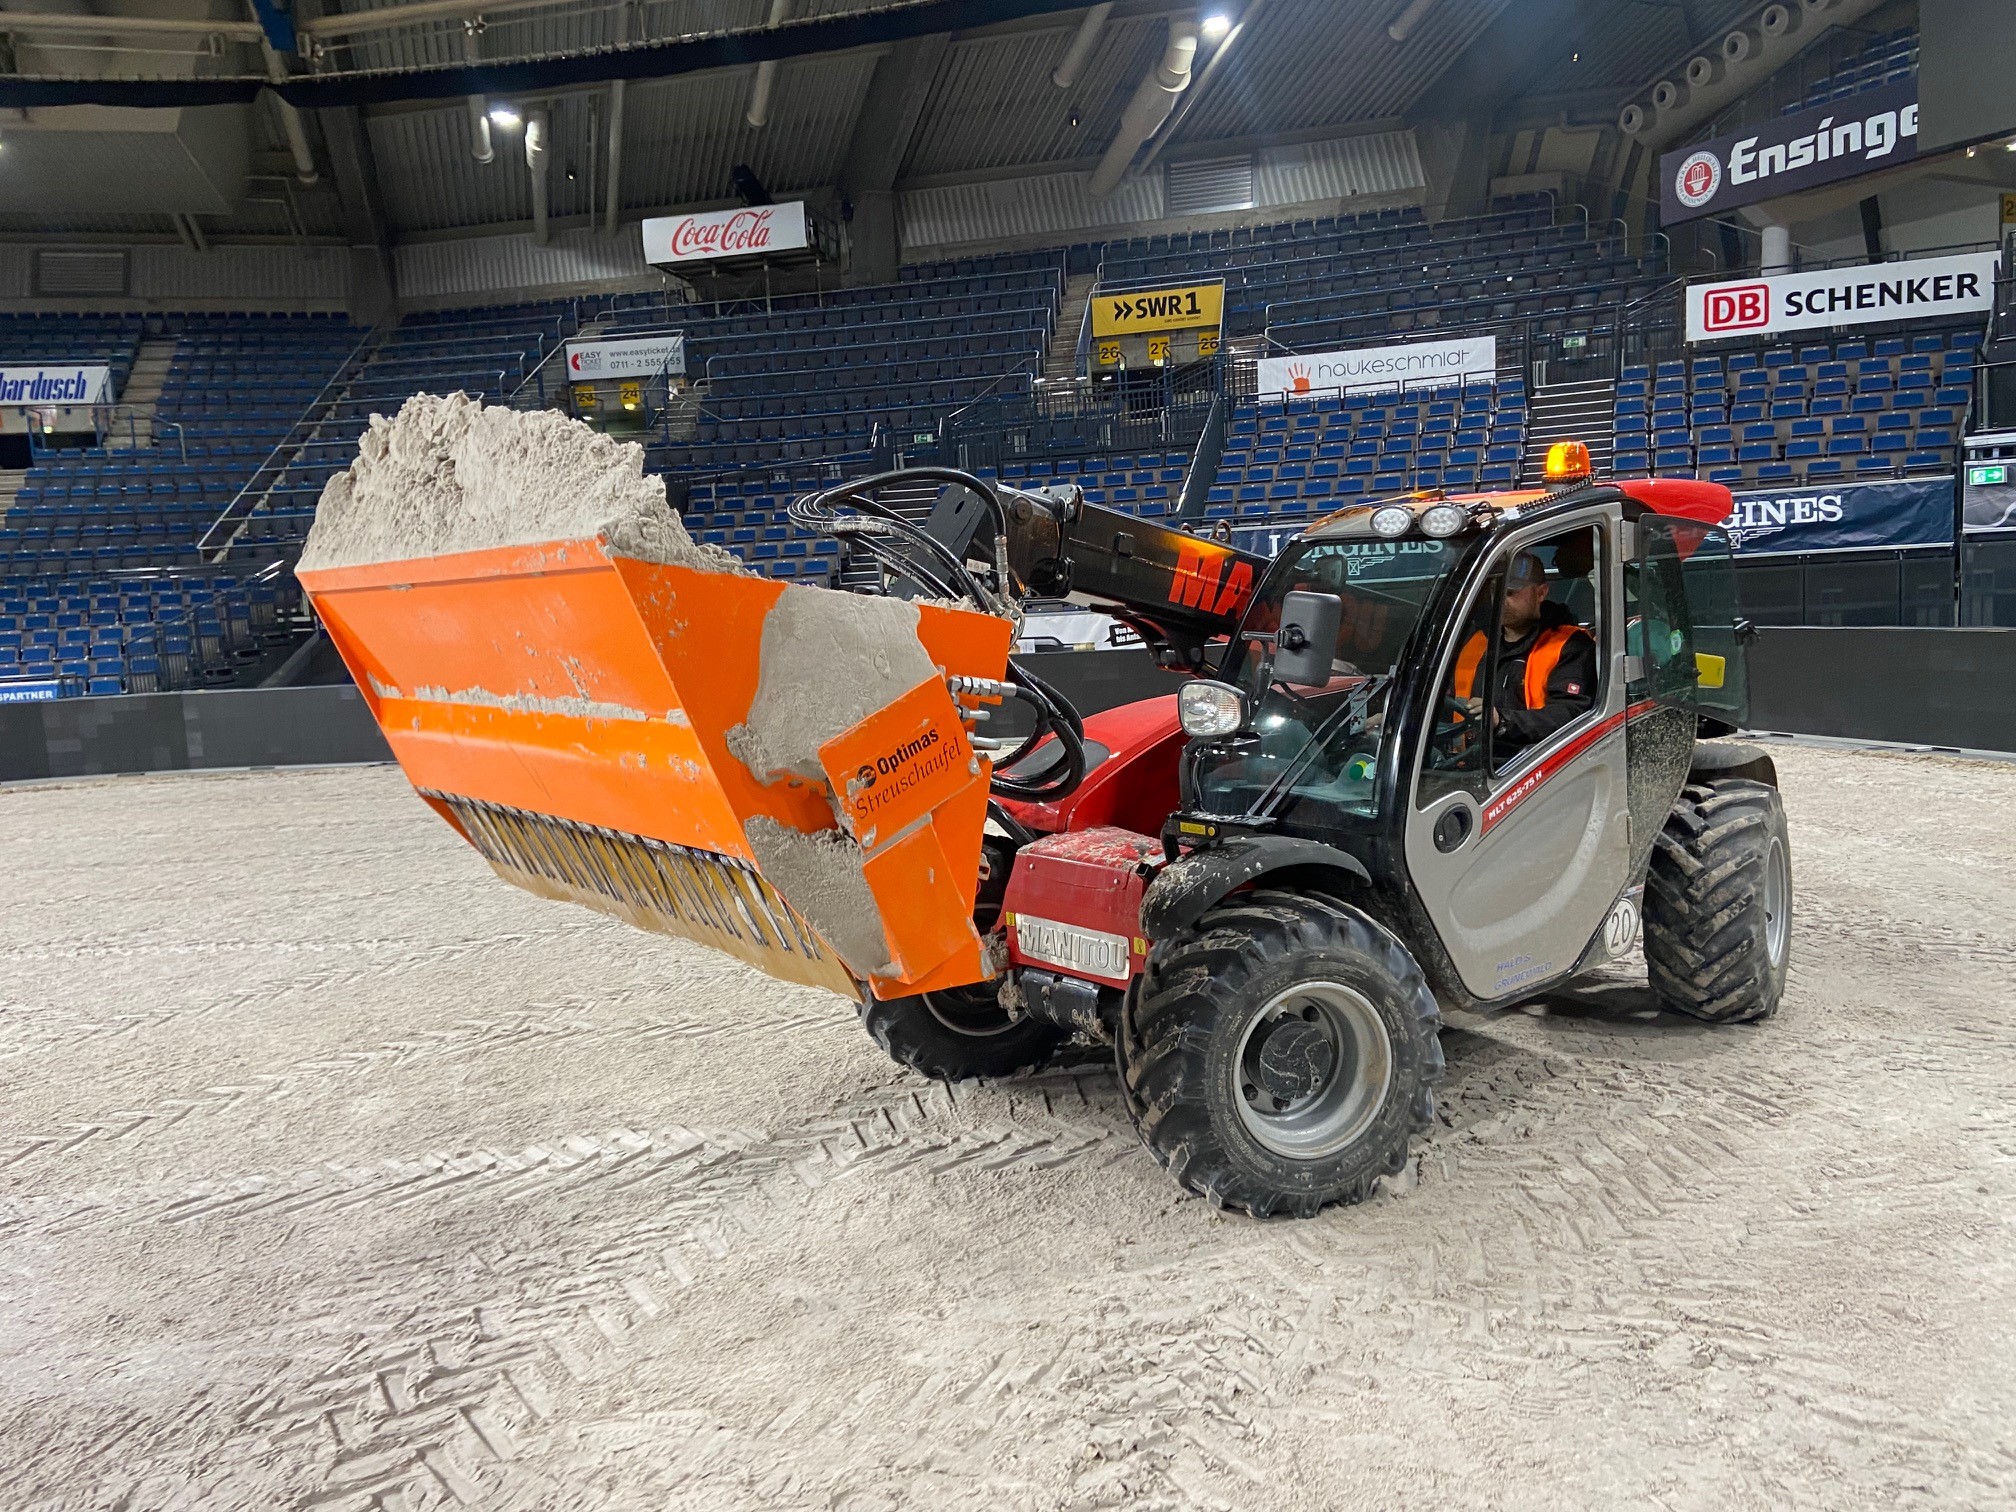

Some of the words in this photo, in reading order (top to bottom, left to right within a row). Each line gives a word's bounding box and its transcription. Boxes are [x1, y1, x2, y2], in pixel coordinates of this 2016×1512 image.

[671, 209, 775, 256] Coca-Cola
[1712, 292, 1761, 325] DB
[1785, 272, 1981, 317] SCHENKER
[580, 351, 601, 360] EASY
[610, 361, 629, 370] 0711
[636, 359, 642, 368] 2
[645, 357, 662, 367] 555
[1101, 346, 1119, 359] 26
[1150, 341, 1169, 355] 27
[1317, 349, 1470, 379] haukeschmidt
[876, 728, 939, 775] Optimas
[856, 736, 961, 819] Streuschaufel
[1488, 801, 1506, 820] MLT
[1506, 777, 1535, 804] 625-75
[1535, 770, 1543, 781] H
[1020, 921, 1127, 973] MANITOU
[1611, 908, 1632, 949] 20
